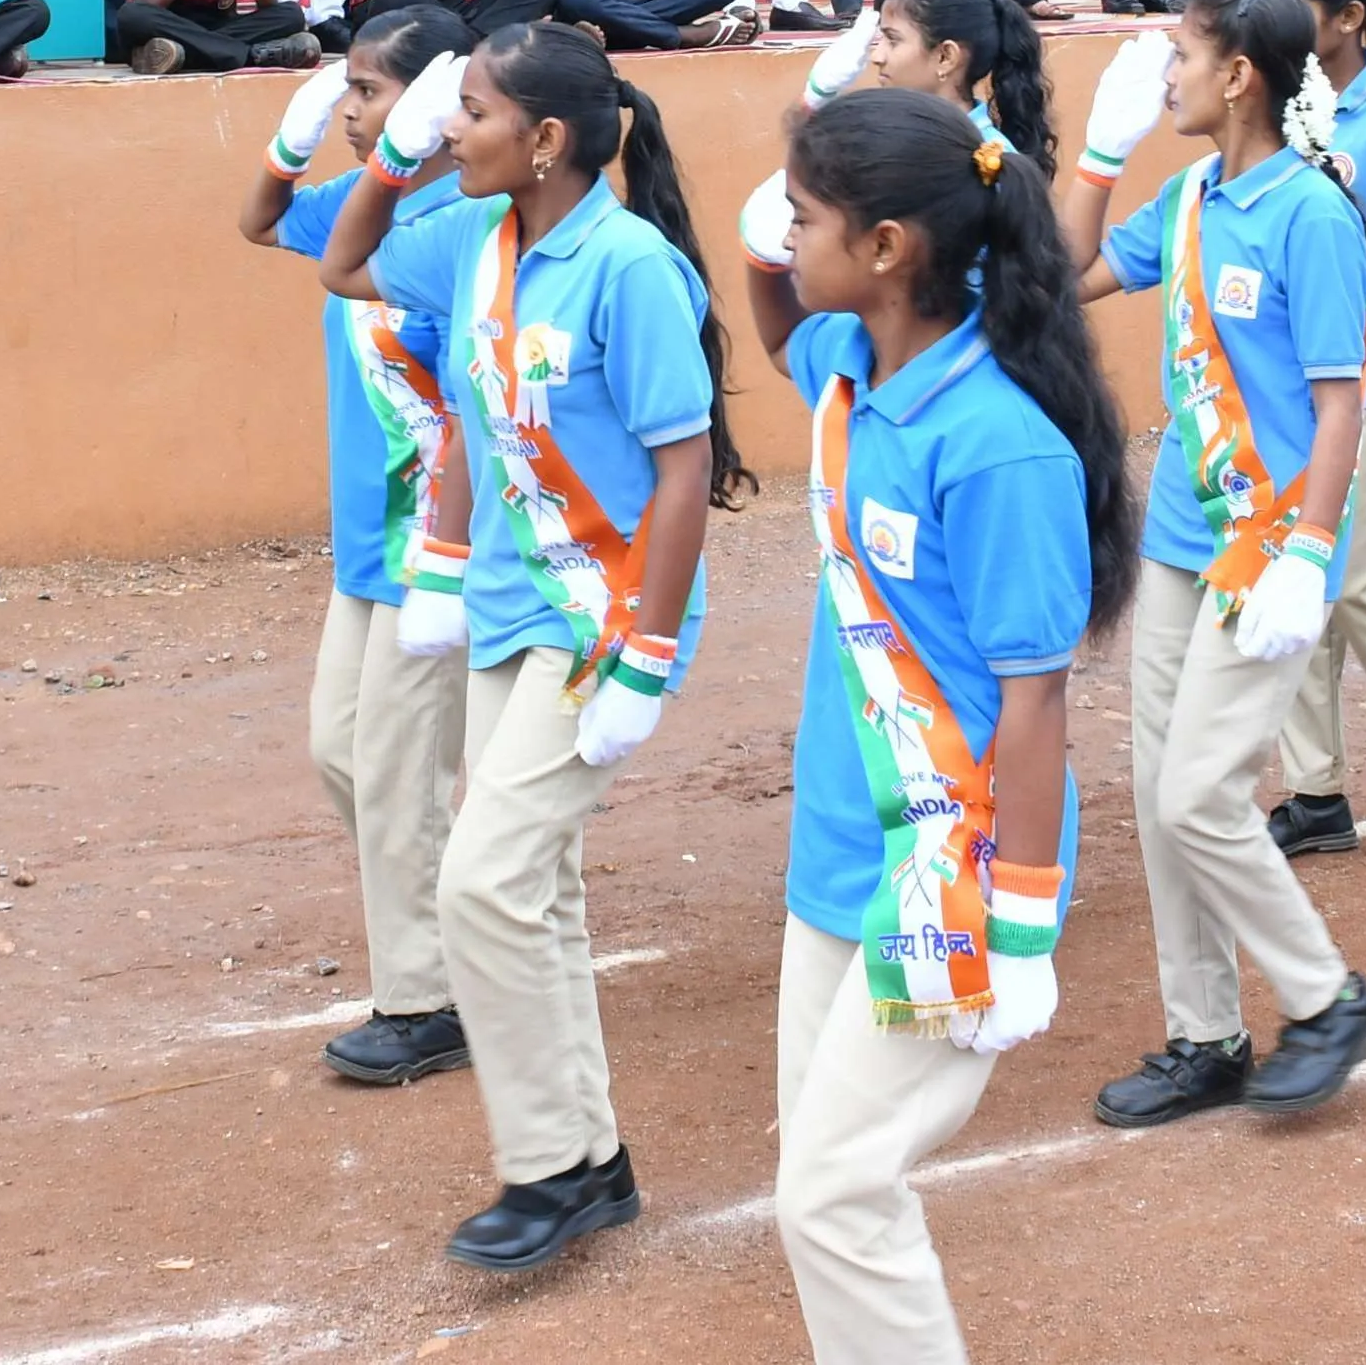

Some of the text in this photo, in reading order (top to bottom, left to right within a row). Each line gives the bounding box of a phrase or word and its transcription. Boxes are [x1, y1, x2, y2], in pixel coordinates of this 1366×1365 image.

[903, 798, 962, 826] INDIA
[878, 924, 974, 962] जय हिन्द
